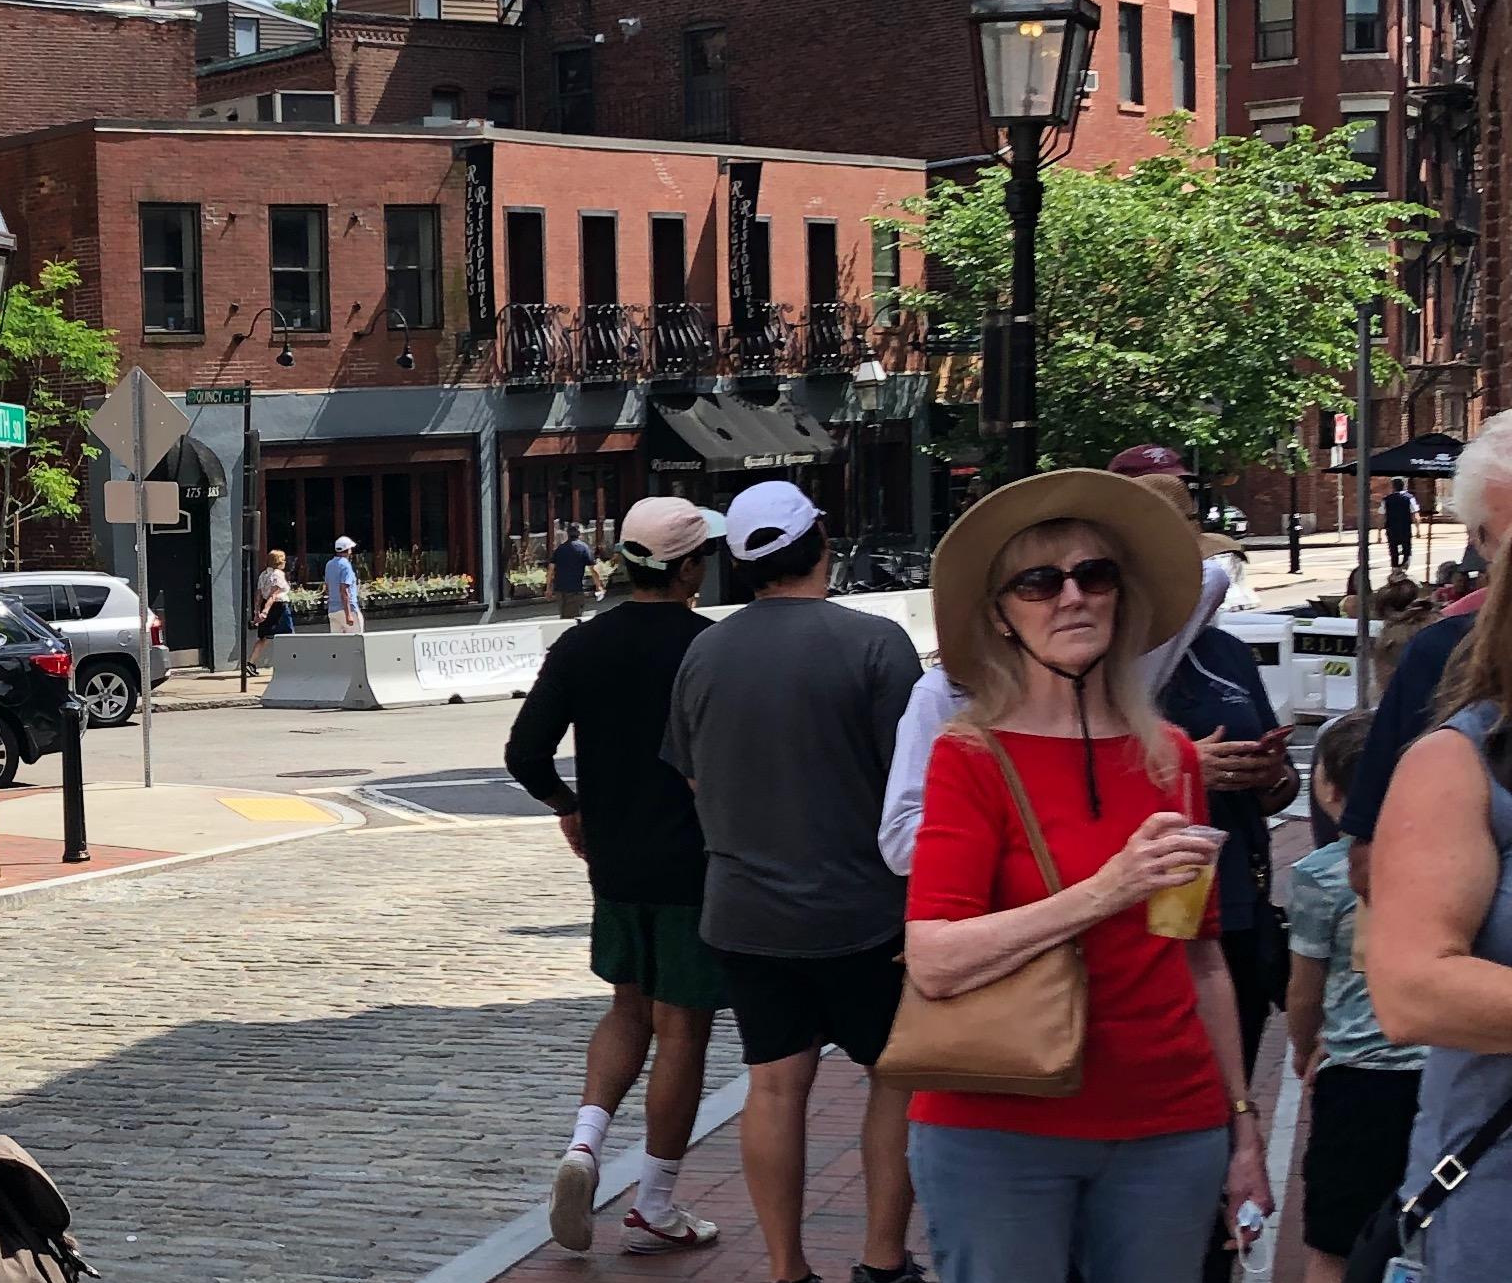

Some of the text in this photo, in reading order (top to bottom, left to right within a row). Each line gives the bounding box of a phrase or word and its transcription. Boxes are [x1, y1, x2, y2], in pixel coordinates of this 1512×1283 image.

[474, 185, 489, 319] Ristorante
[196, 390, 223, 403] QUINCY
[185, 487, 201, 498] 175
[421, 635, 516, 661] RICCARDO'S
[438, 652, 539, 679] RISTORANTE
